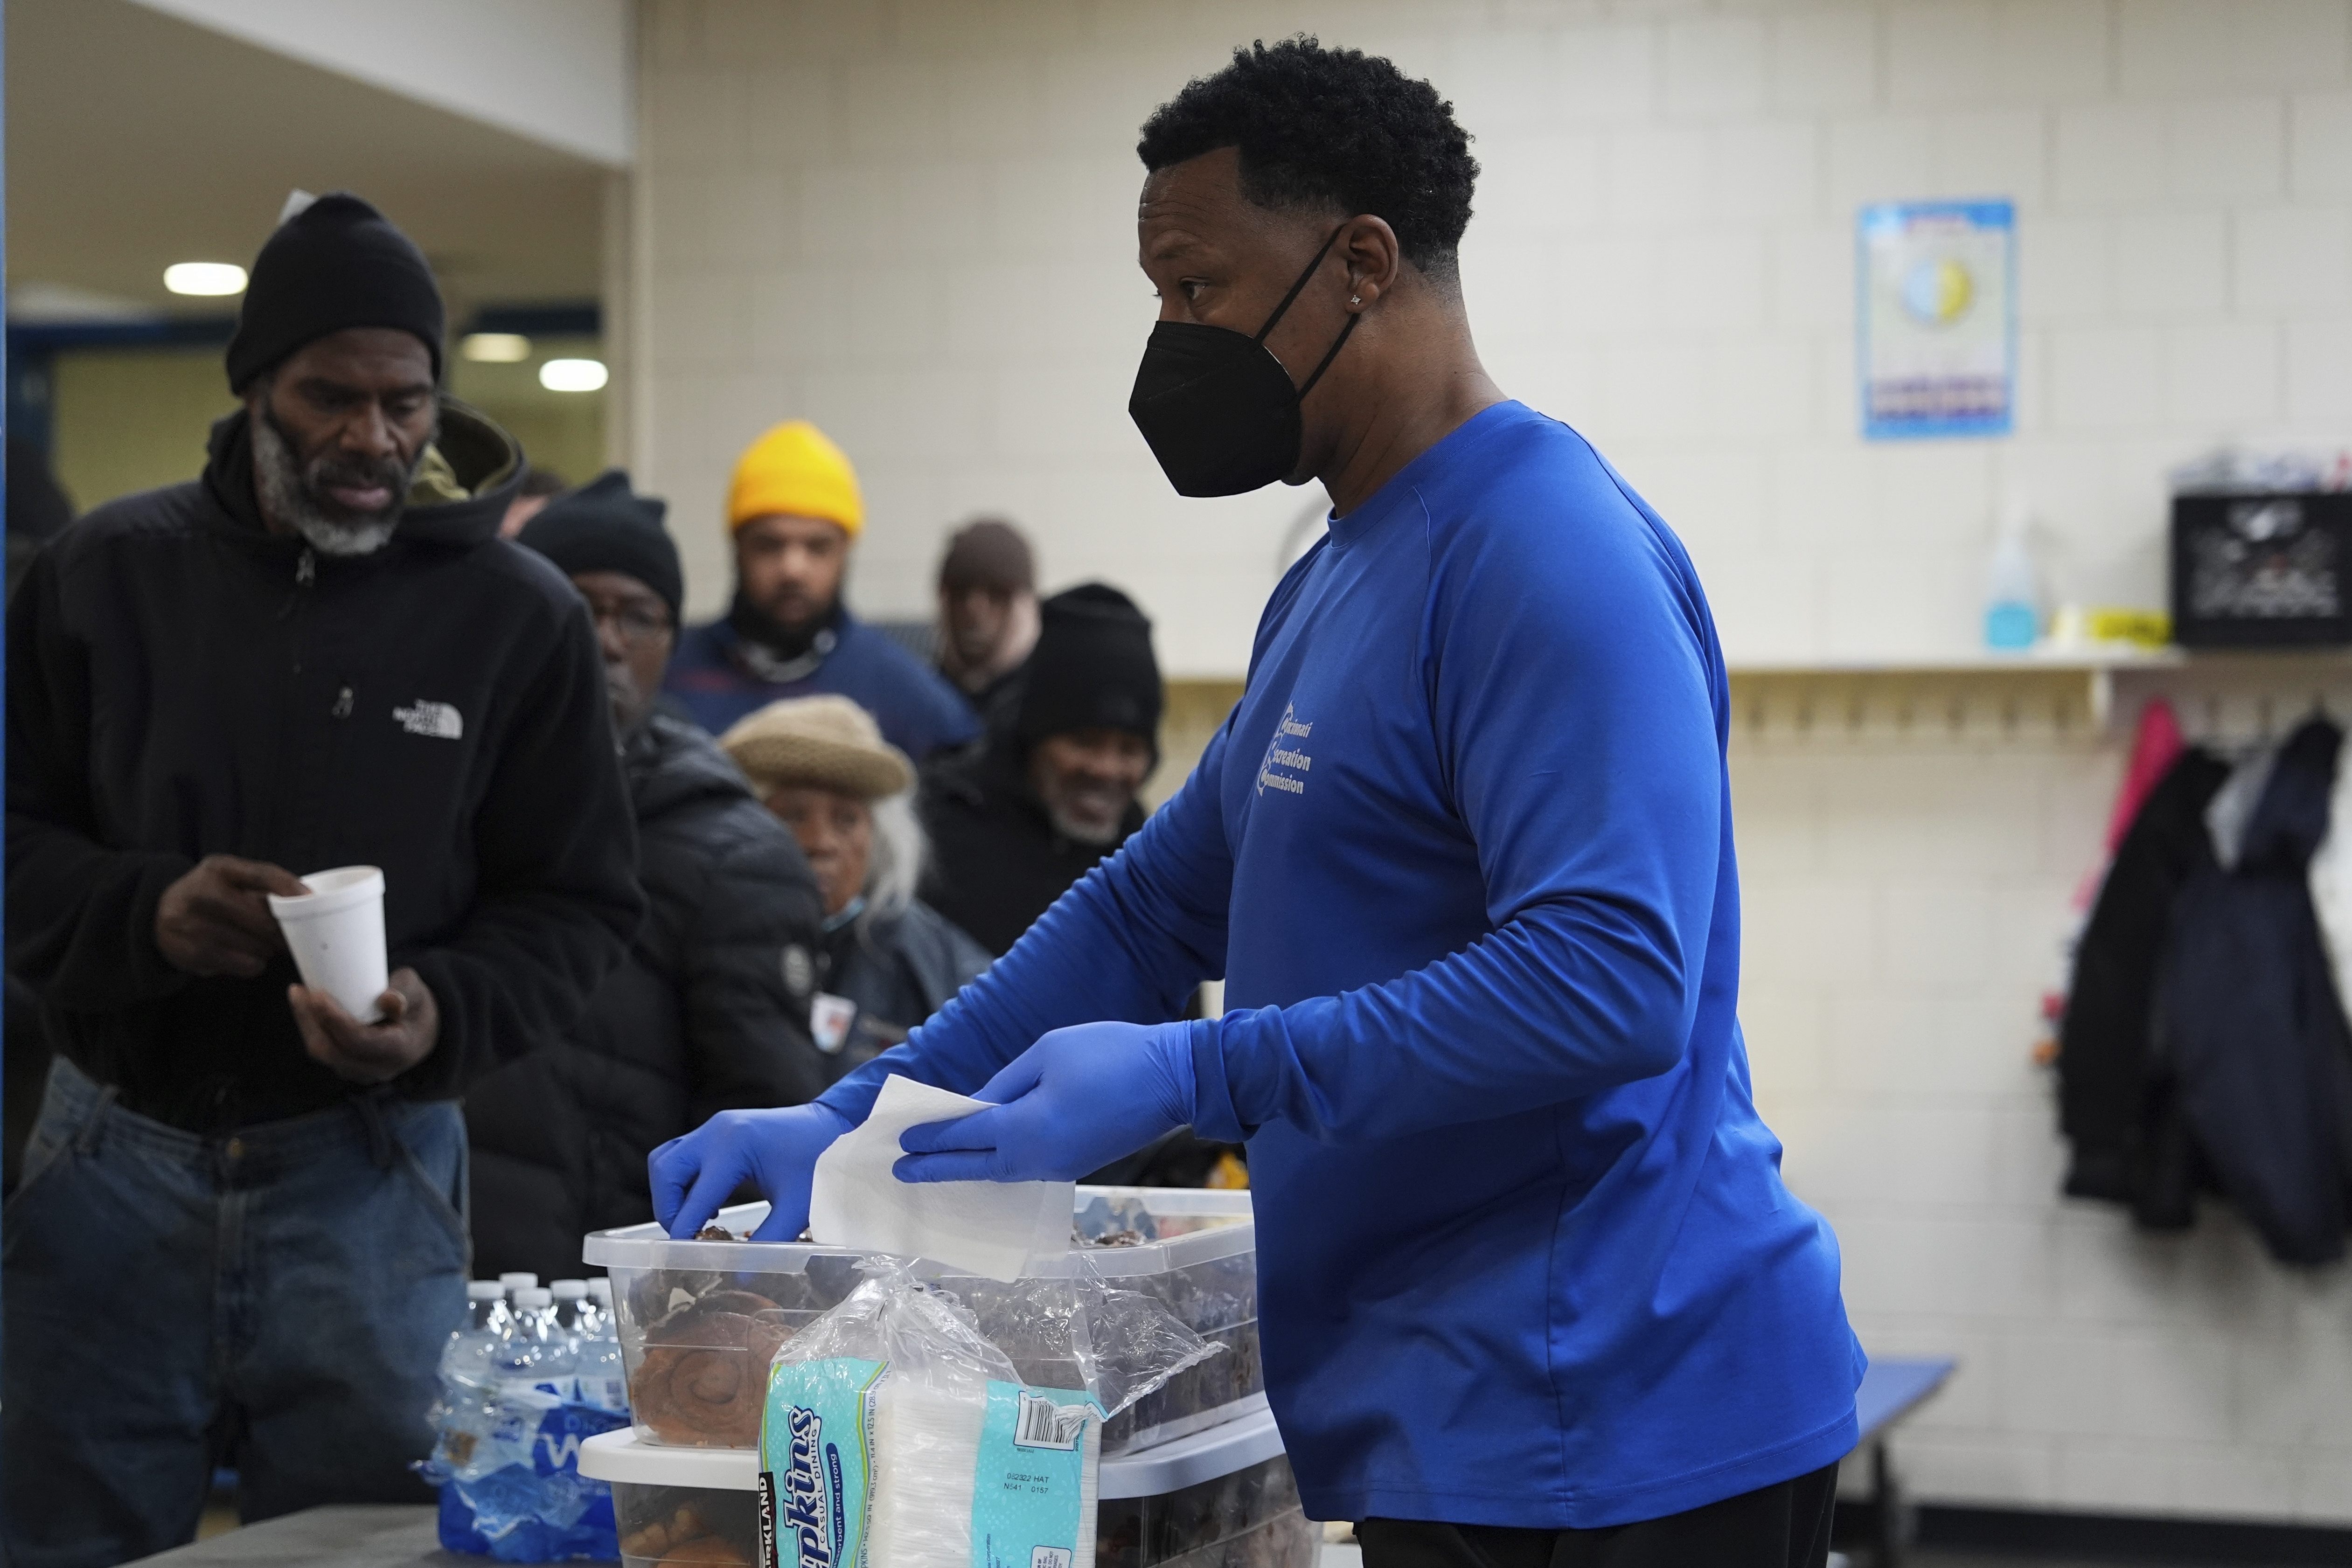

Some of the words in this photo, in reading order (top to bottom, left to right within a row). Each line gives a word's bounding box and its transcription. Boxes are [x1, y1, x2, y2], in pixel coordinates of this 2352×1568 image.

[811, 1429, 821, 1479] DINING
[830, 1454, 840, 1489] strong
[785, 1408, 829, 1568] pkins
[1034, 1475, 1050, 1484] HAT
[759, 1477, 772, 1568] IRKLAND
